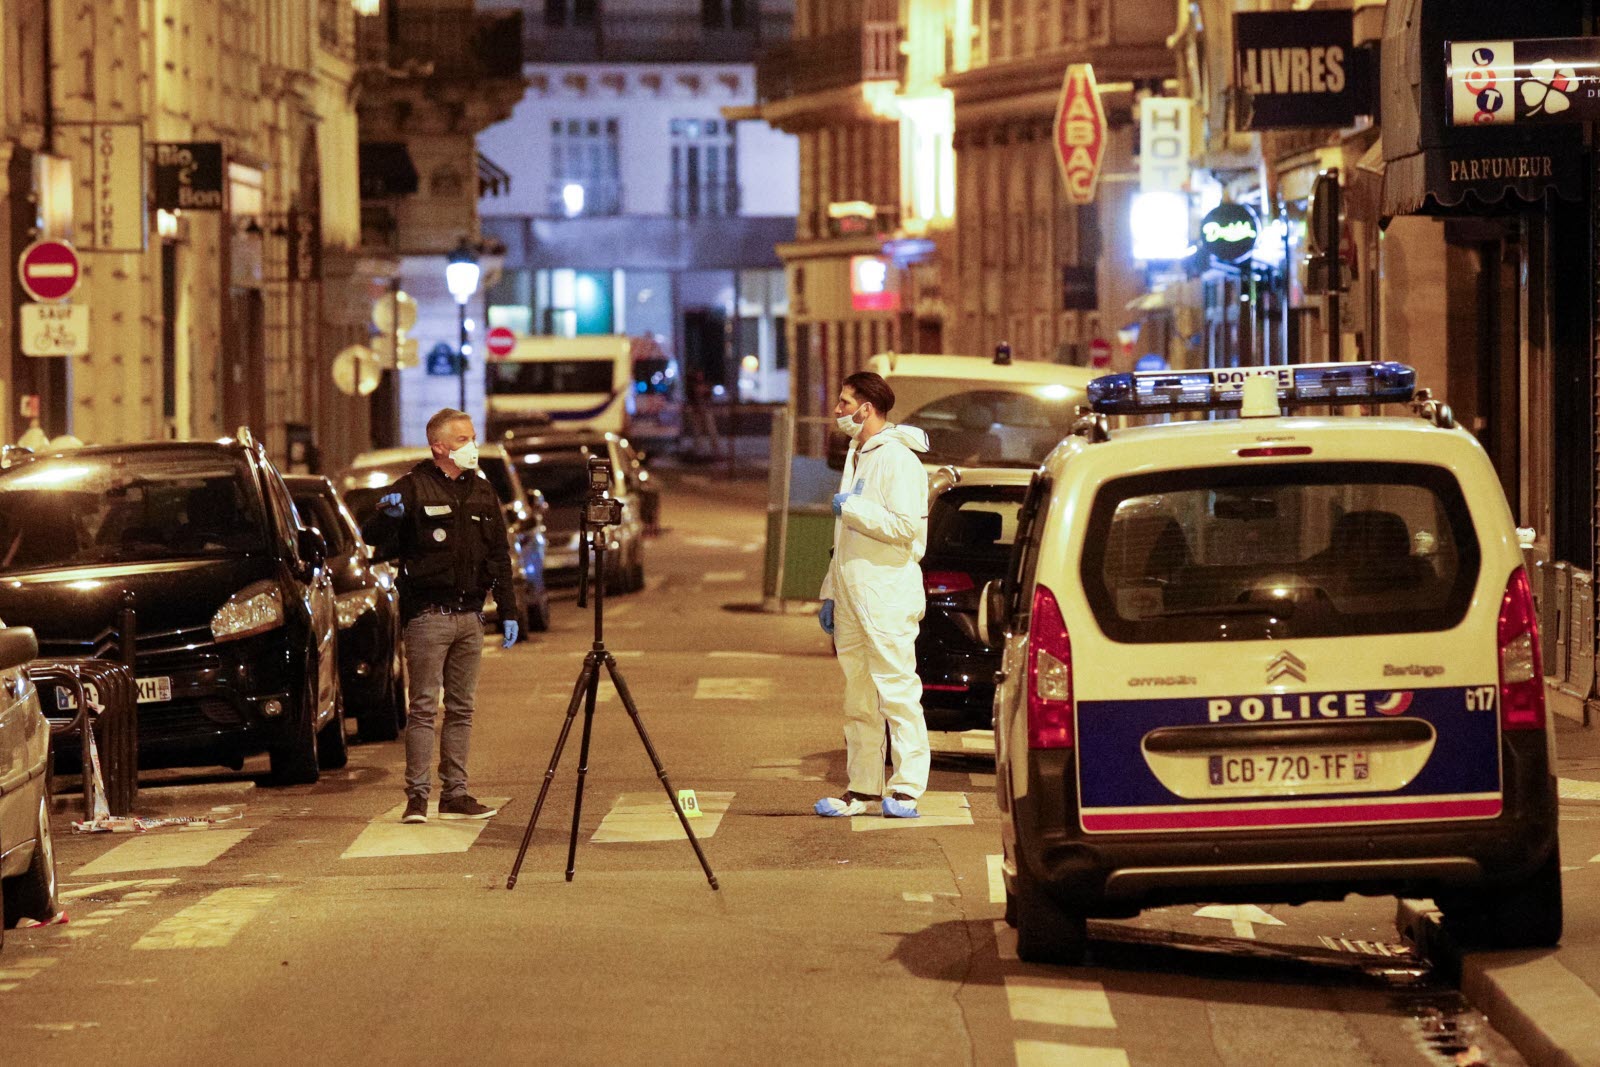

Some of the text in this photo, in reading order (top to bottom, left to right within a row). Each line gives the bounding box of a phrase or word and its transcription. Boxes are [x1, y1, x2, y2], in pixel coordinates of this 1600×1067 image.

[1248, 47, 1345, 94] LIVRES
[1065, 68, 1097, 195] TABAC
[1450, 157, 1552, 182] PARFUMEUR
[101, 129, 113, 245] COIFFURE
[1217, 369, 1289, 389] POE
[1208, 692, 1367, 723] POLICE
[680, 796, 695, 810] 19
